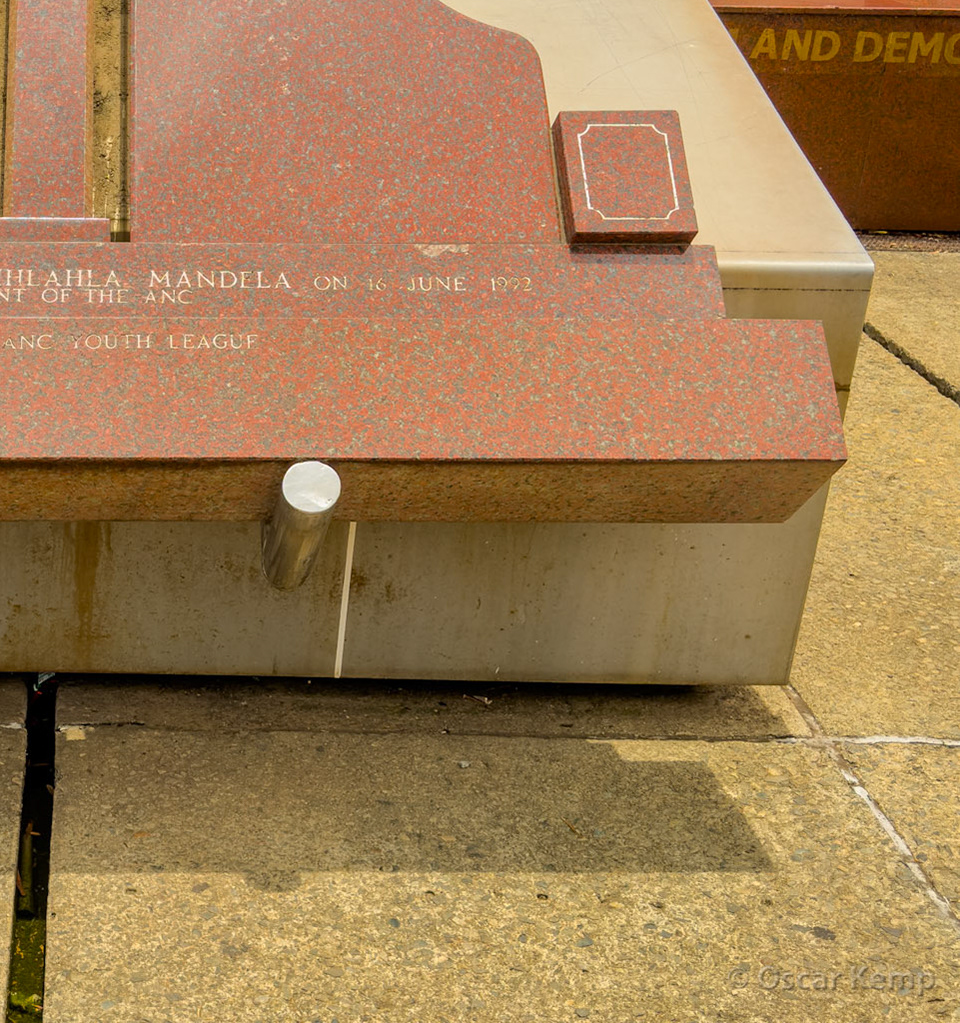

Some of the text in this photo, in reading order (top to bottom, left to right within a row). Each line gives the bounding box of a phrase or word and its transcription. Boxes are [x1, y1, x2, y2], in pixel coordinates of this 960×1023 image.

[749, 28, 840, 62] AND
[148, 269, 291, 289] MANDELA
[313, 275, 348, 292] ON
[368, 277, 387, 292] 16
[406, 276, 467, 293] JUNE
[490, 276, 533, 293] 1992
[41, 288, 71, 304] OF
[87, 288, 129, 305] THE
[144, 289, 193, 305] ANC
[4, 334, 54, 350] ANC
[71, 334, 151, 351] YOUTH
[169, 334, 259, 351] LEAGUE
